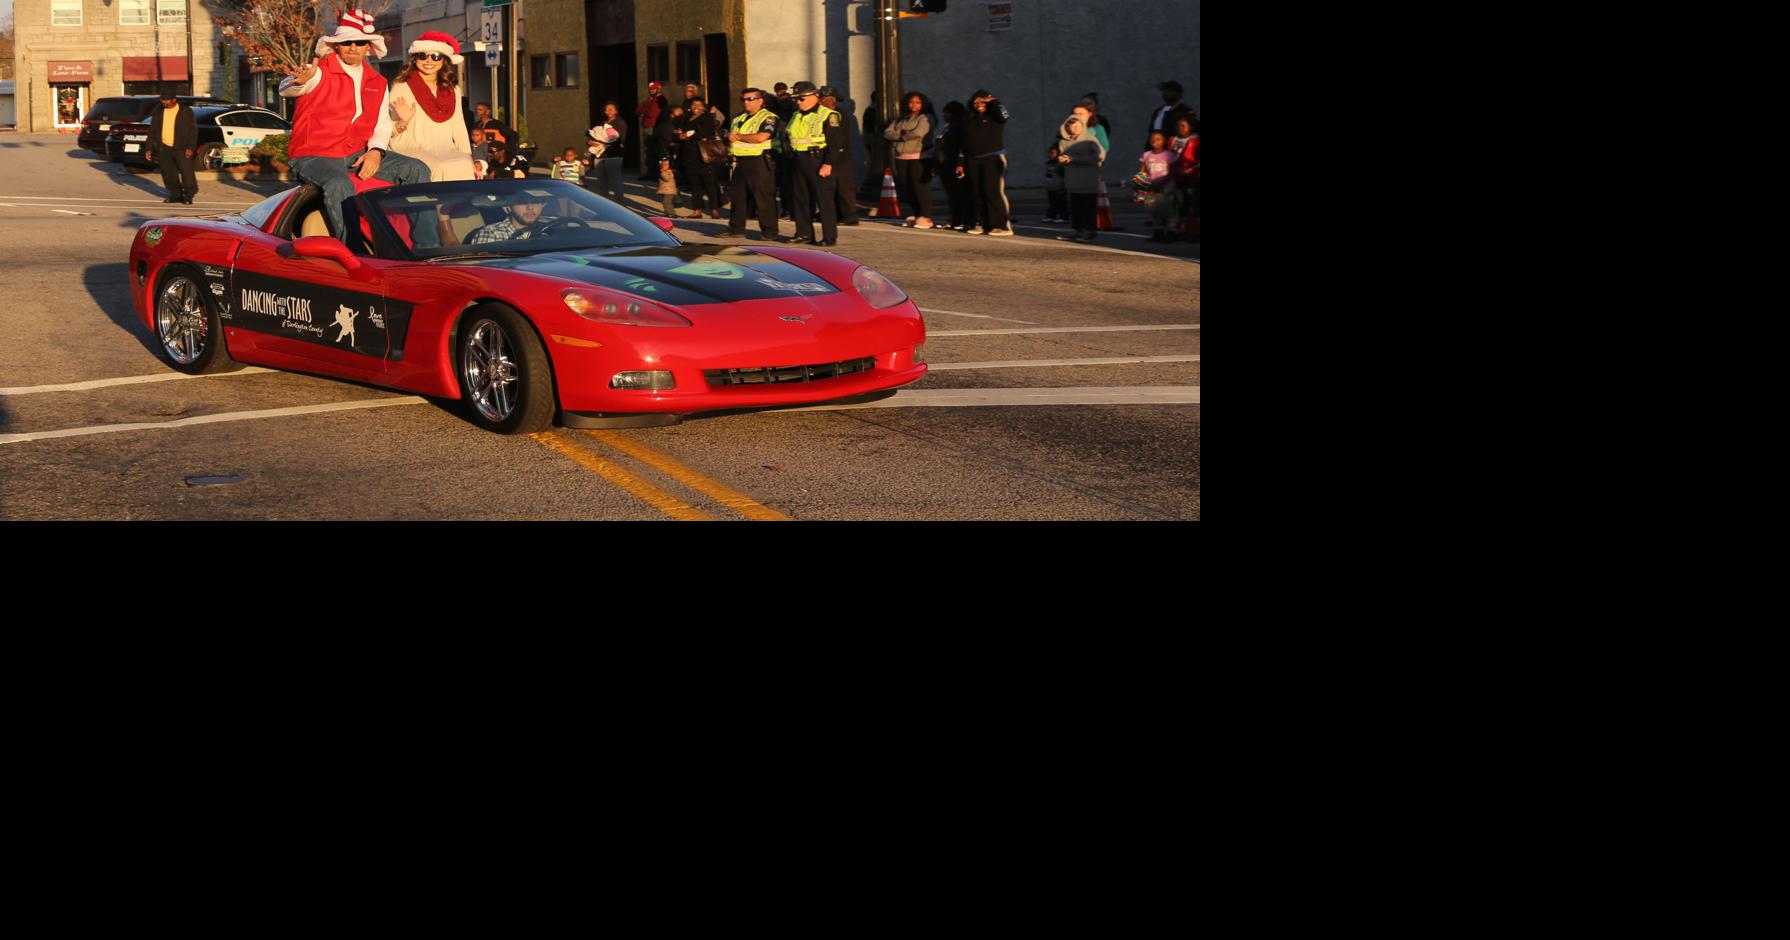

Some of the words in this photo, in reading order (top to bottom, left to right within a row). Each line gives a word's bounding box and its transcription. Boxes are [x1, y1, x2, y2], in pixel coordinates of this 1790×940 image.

[485, 22, 498, 41] 34
[123, 134, 148, 142] POLICE
[242, 288, 277, 317] DANCING
[278, 306, 286, 316] THE
[286, 296, 312, 323] STARS
[308, 324, 324, 338] County
